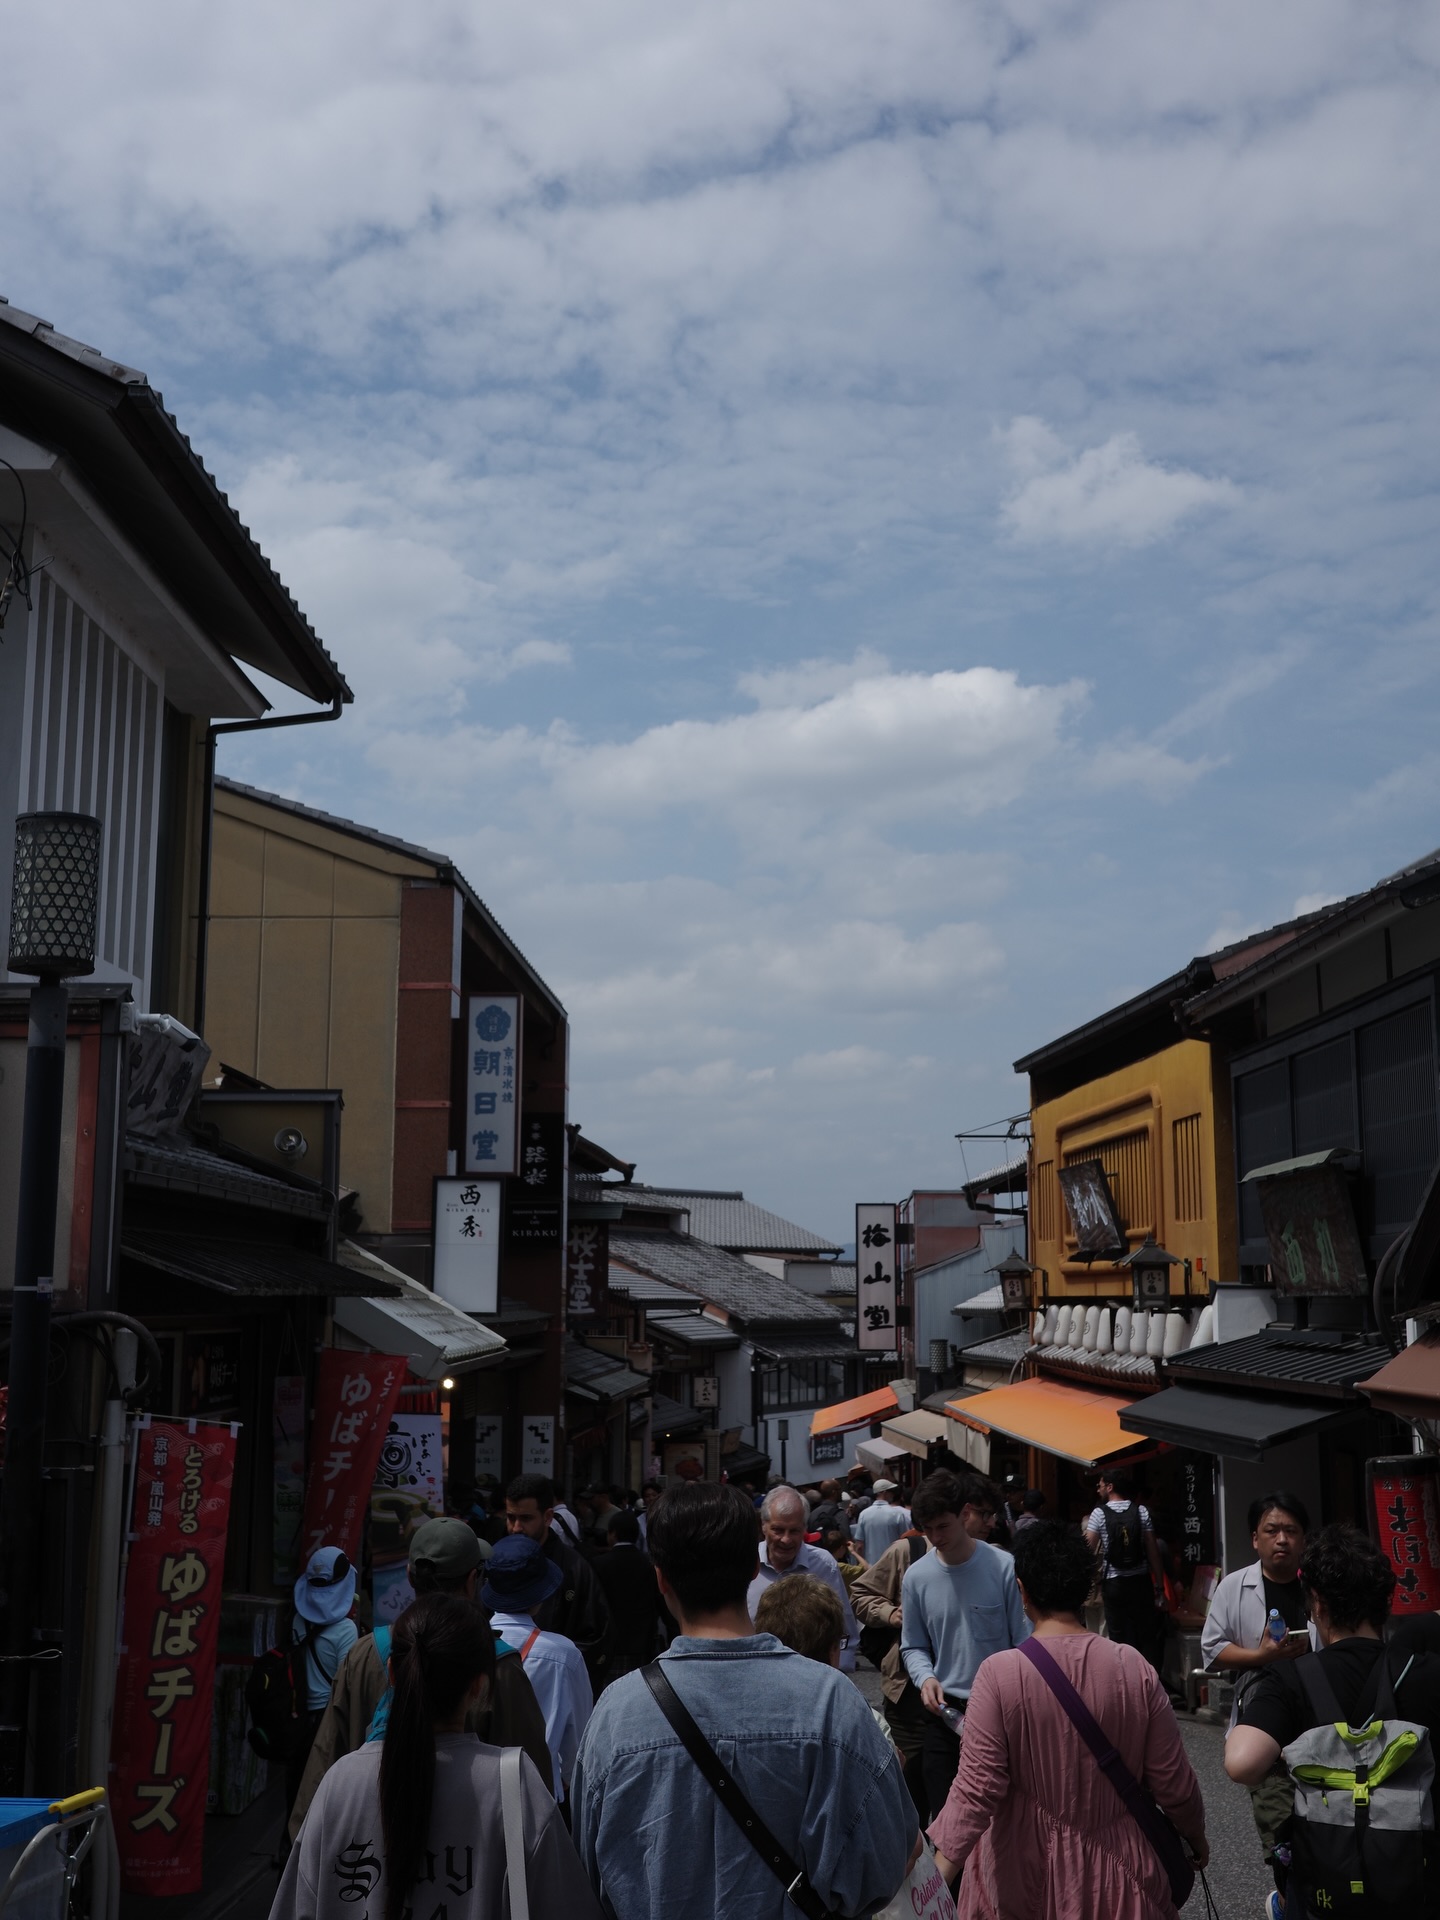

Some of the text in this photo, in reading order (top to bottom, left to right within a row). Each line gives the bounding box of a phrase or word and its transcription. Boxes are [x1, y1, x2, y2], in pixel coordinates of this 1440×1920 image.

[473, 1049, 501, 1160] 朝日堂
[502, 1046, 514, 1103] 京・清水焼
[459, 1184, 481, 1237] 西秀
[863, 1223, 893, 1332] 梅山堂
[147, 1436, 169, 1527] 京都・嵐山発
[179, 1446, 203, 1534] とろける
[1184, 1464, 1201, 1562] 京つけもの 西利
[130, 1550, 208, 1834] ゆばチーズ
